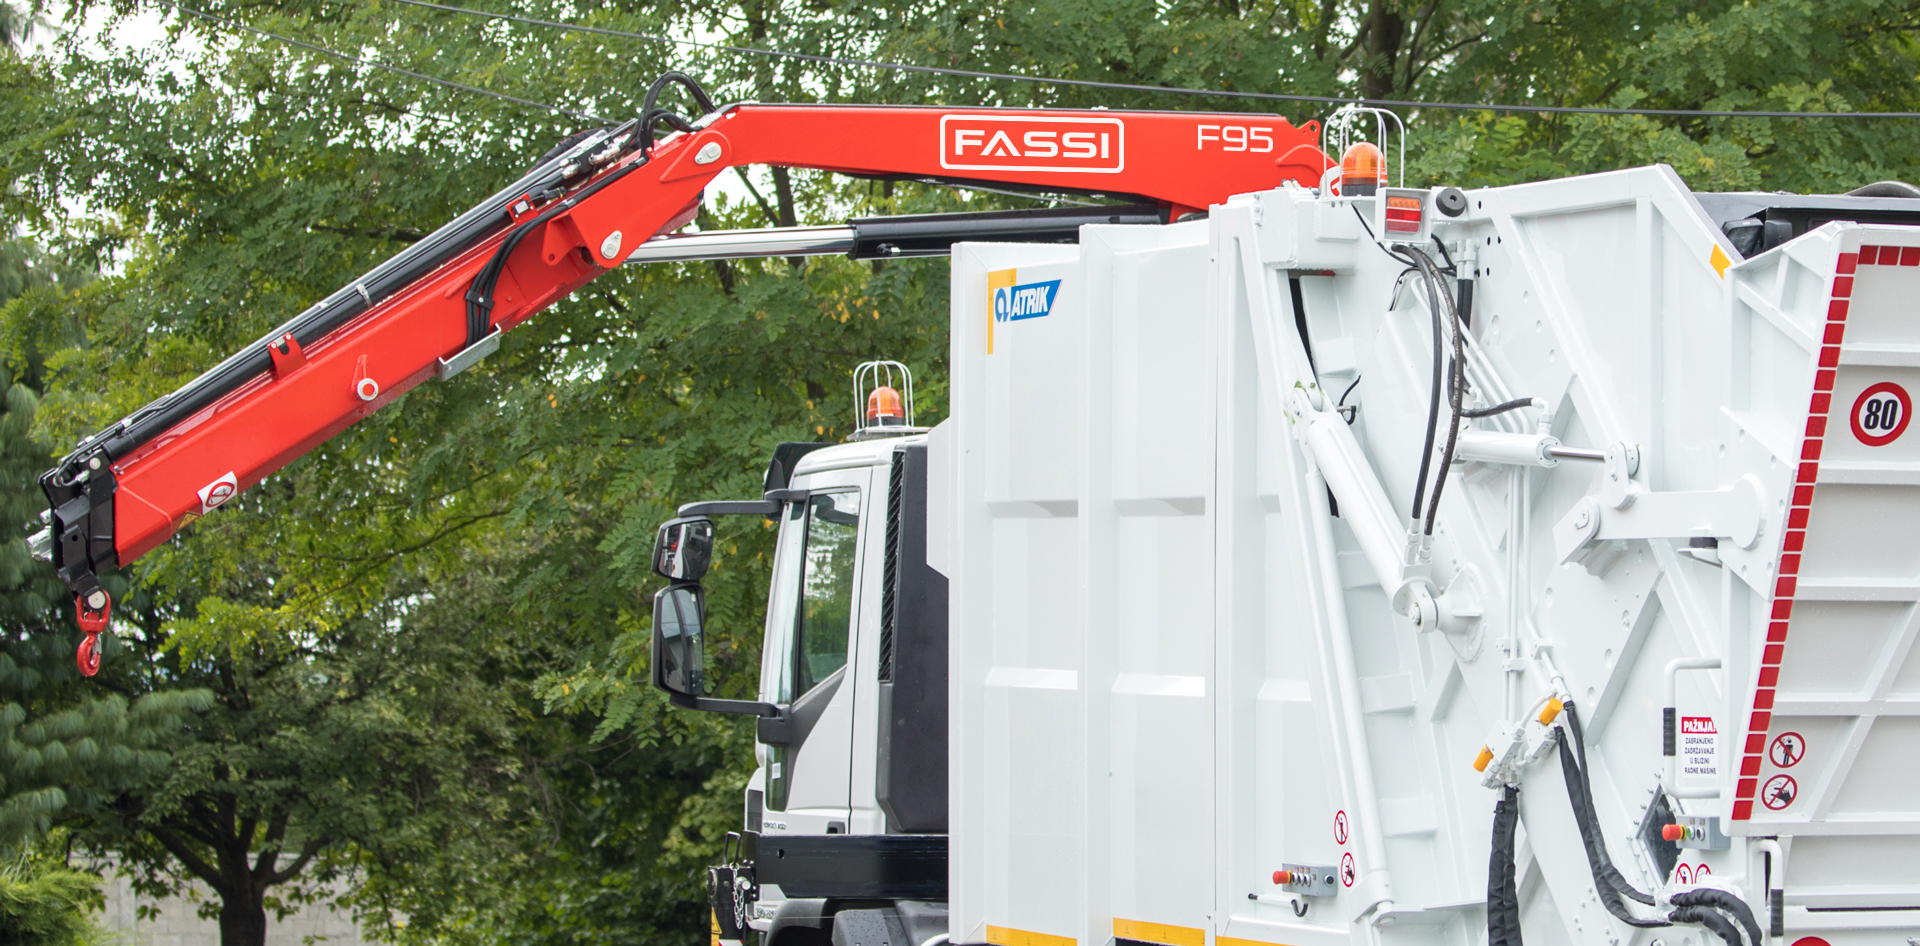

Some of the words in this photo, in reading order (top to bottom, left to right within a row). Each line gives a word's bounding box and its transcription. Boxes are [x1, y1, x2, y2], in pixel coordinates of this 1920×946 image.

[955, 129, 1109, 159] FASSI
[1197, 124, 1274, 153] F95
[1011, 285, 1051, 317] ATRIK
[1864, 398, 1898, 431] 80
[1685, 746, 1714, 754] ZADRŽAVANJE
[1700, 766, 1716, 774] MAŠINE
